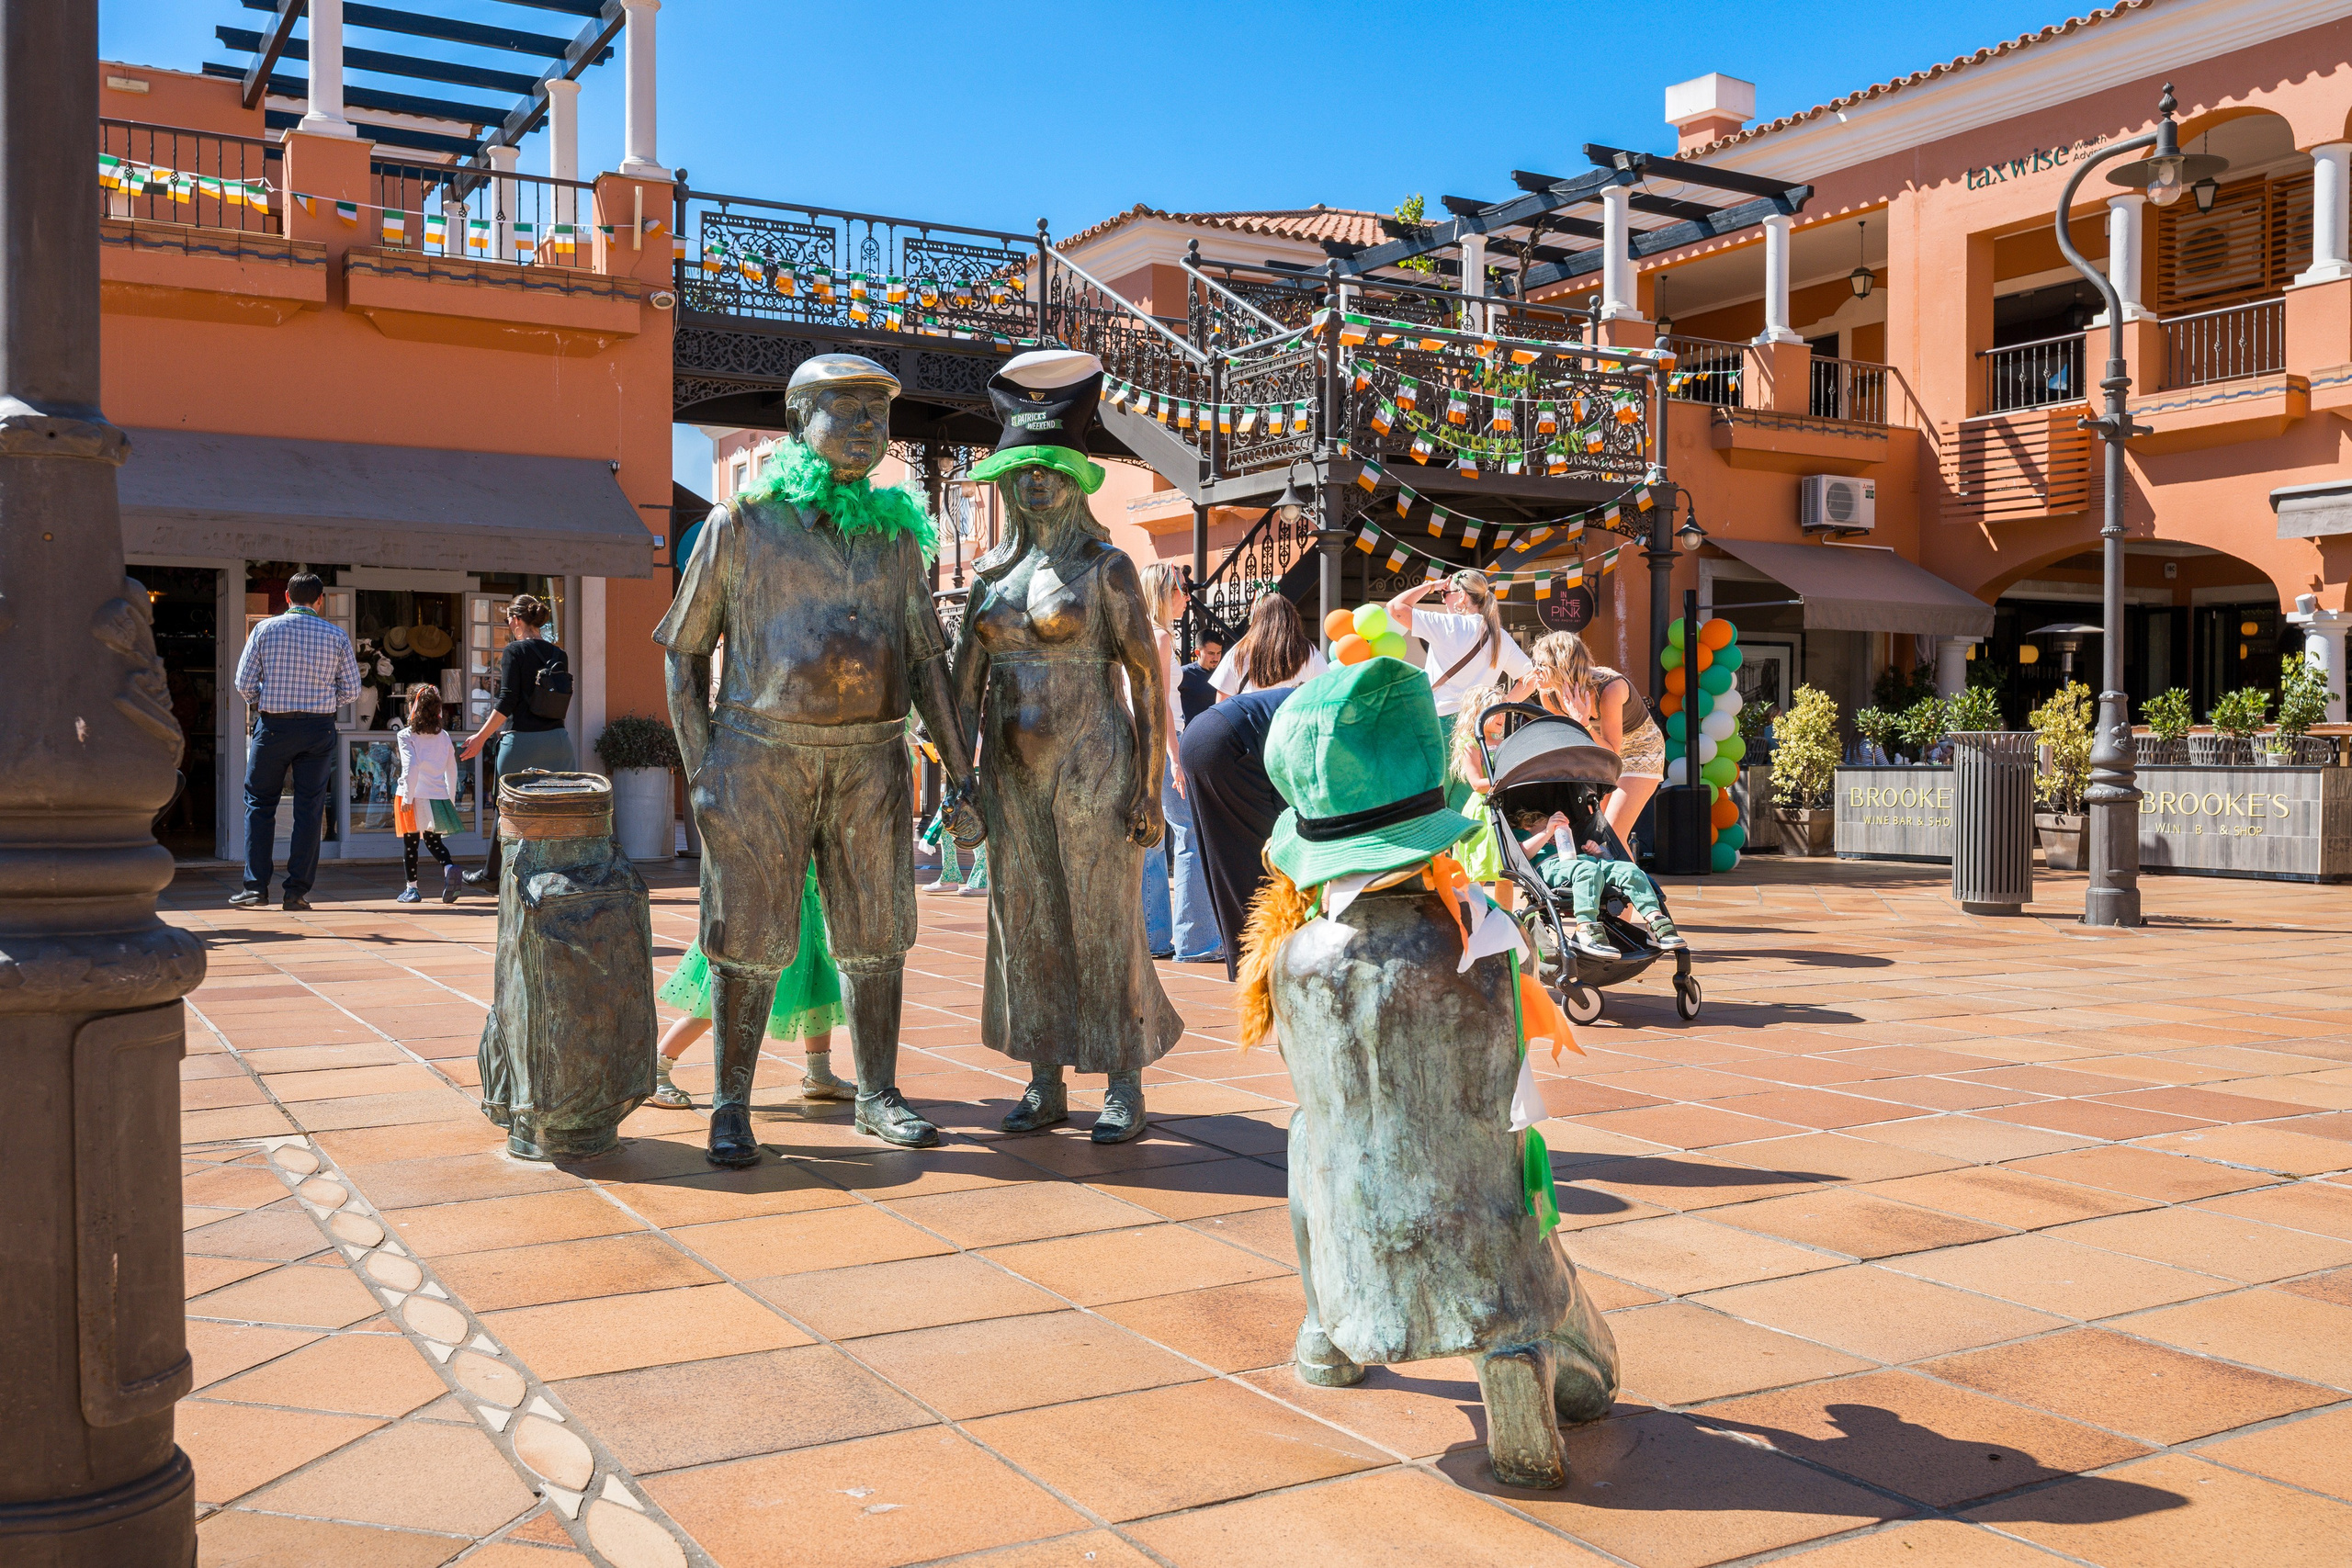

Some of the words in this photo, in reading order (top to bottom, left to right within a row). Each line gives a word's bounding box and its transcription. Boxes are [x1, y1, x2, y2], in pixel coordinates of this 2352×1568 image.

[2073, 135, 2107, 151] Wealth
[1966, 145, 2069, 190] taxwise
[1027, 420, 1056, 430] WEEKEND
[1560, 591, 1567, 599] IN
[1561, 599, 1580, 607] THE
[1551, 606, 1580, 617] PINK
[1849, 787, 1954, 809] BROOKE'
[2140, 791, 2290, 819] BROOKE'S
[1863, 815, 1890, 825] WINE
[1893, 816, 1913, 826] BAR
[1917, 817, 1925, 827] &
[1928, 817, 1951, 828] SHO
[2220, 824, 2229, 836] &
[2233, 825, 2263, 837] SHOP
